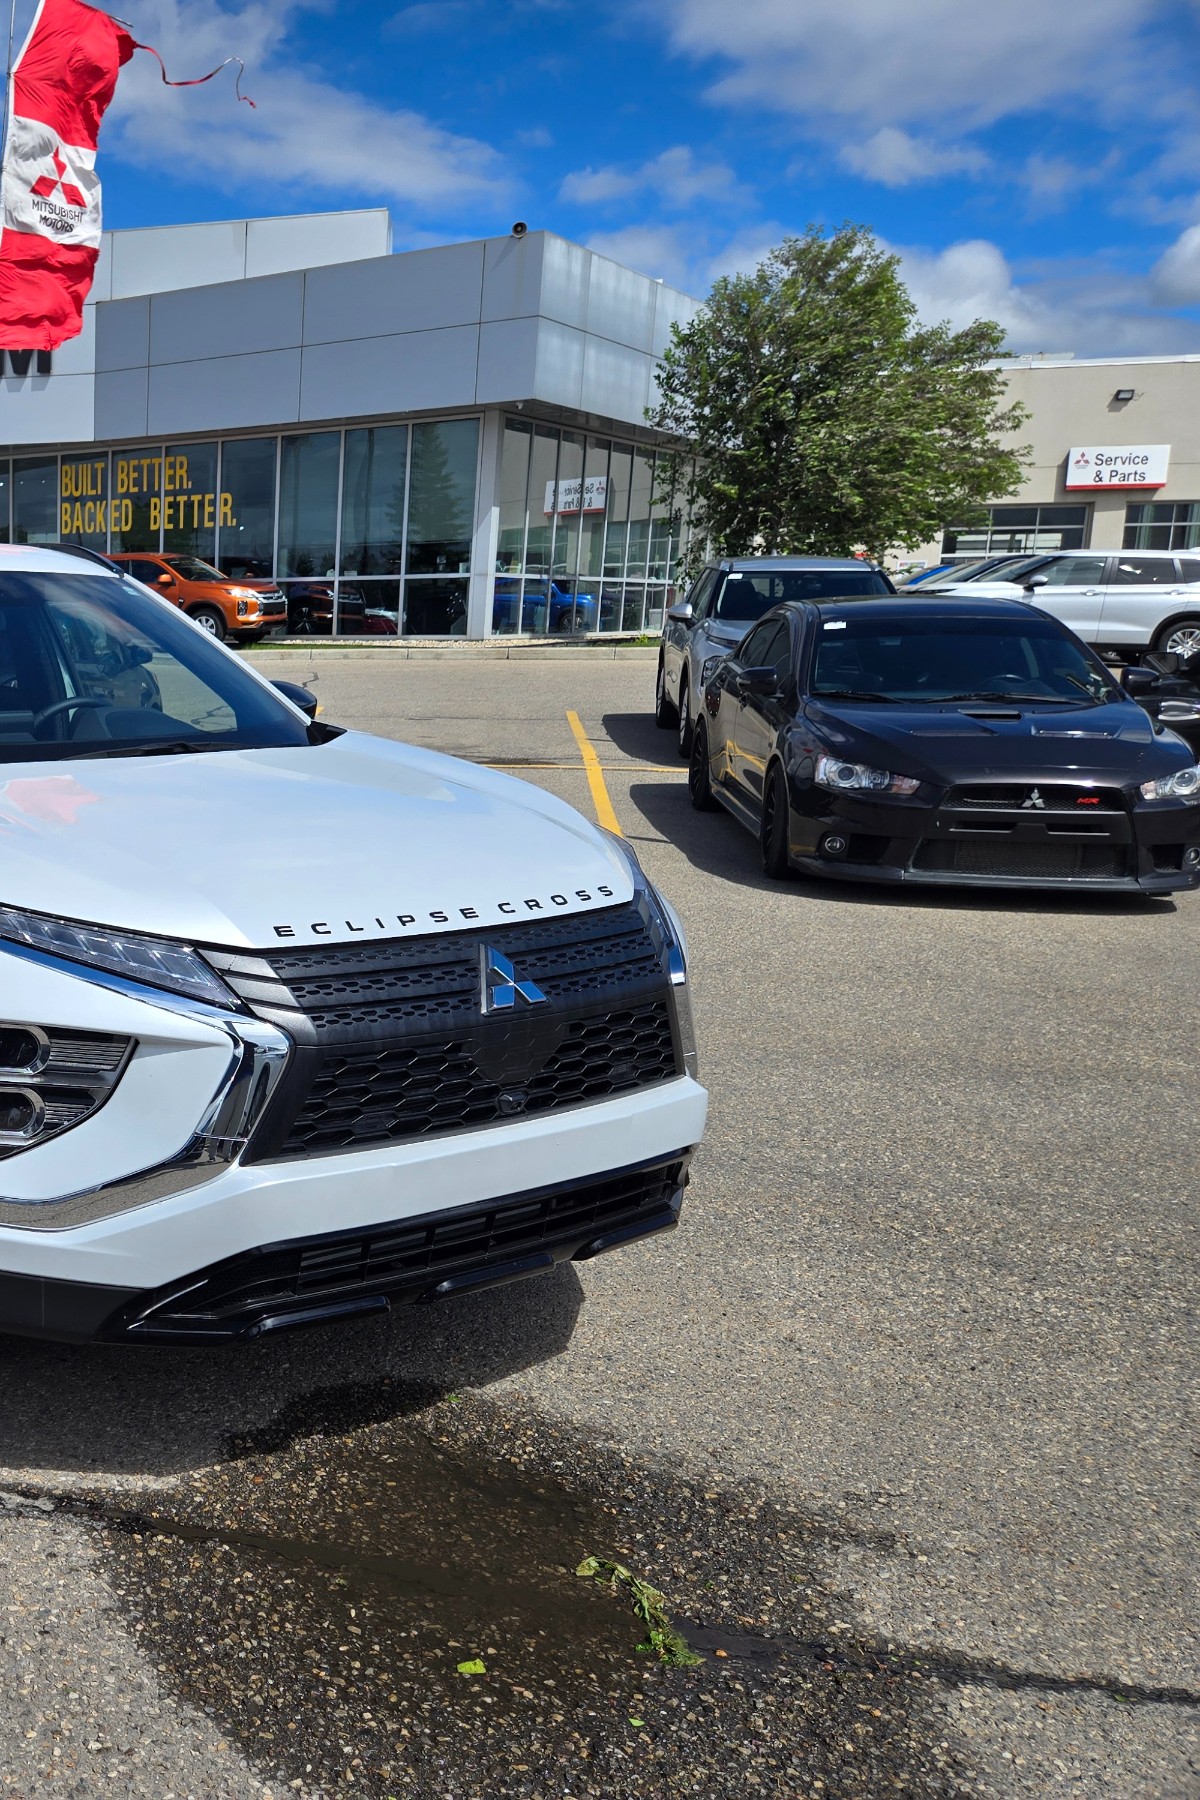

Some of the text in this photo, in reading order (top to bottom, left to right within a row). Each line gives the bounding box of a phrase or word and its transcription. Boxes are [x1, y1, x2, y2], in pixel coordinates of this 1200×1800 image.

[31, 199, 84, 223] MITSUBISHI
[39, 214, 75, 233] MOTORS
[1094, 452, 1149, 466] Service
[61, 455, 193, 498] BUILT BETTER.
[1093, 469, 1146, 483] & Parts
[61, 492, 237, 535] BACKED BETTER.
[273, 885, 614, 938] ECLIPSE CROSS
